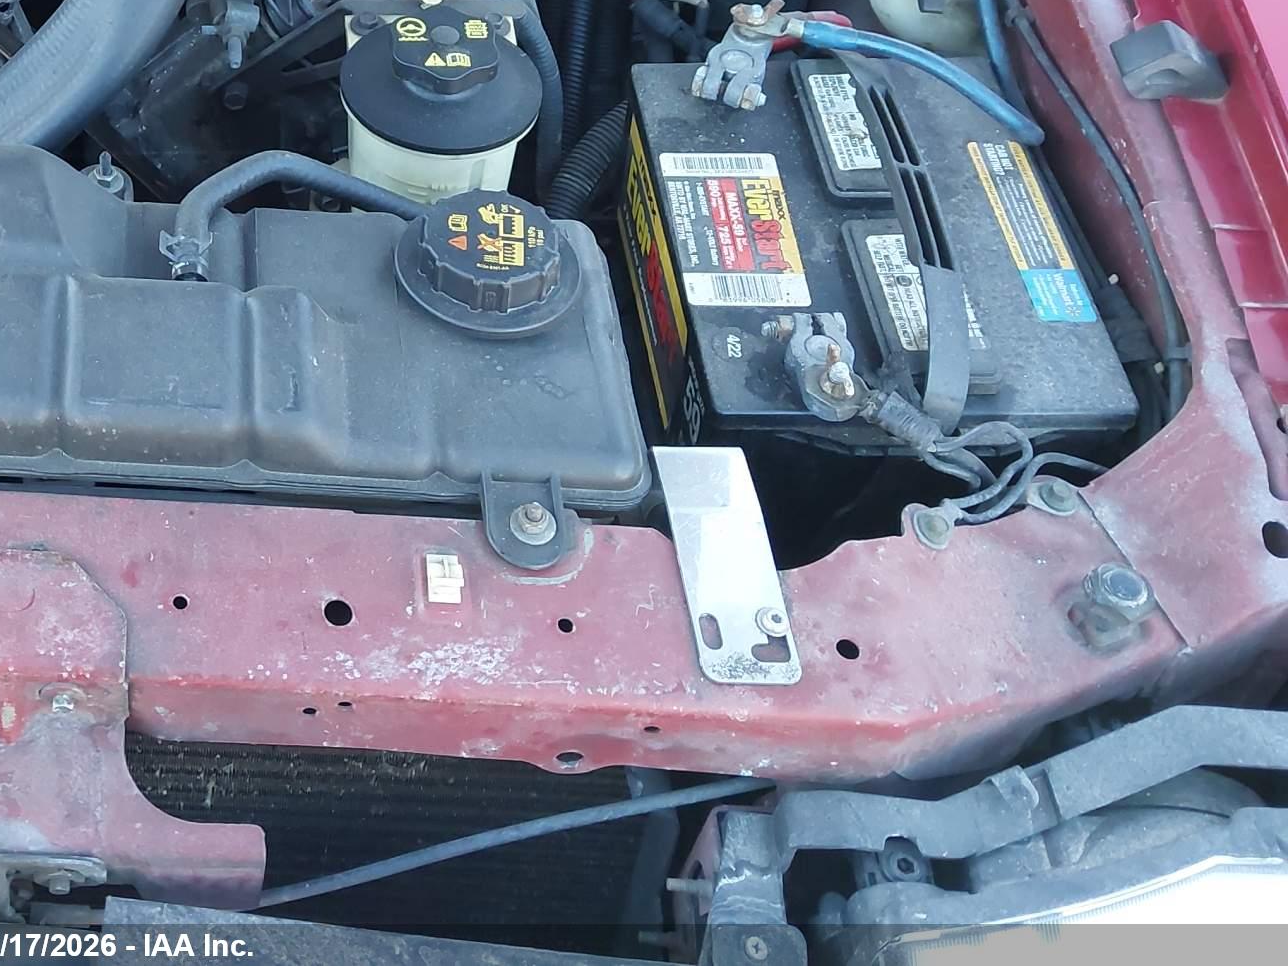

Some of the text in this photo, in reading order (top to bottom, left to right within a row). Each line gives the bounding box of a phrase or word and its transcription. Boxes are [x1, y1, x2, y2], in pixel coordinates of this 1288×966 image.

[982, 143, 1005, 175] STARTING?
[771, 190, 786, 220] maxx
[739, 179, 792, 270] EverStart
[627, 154, 678, 363] EverStart
[1053, 273, 1075, 307] Walmart
[727, 334, 742, 358] 4/22
